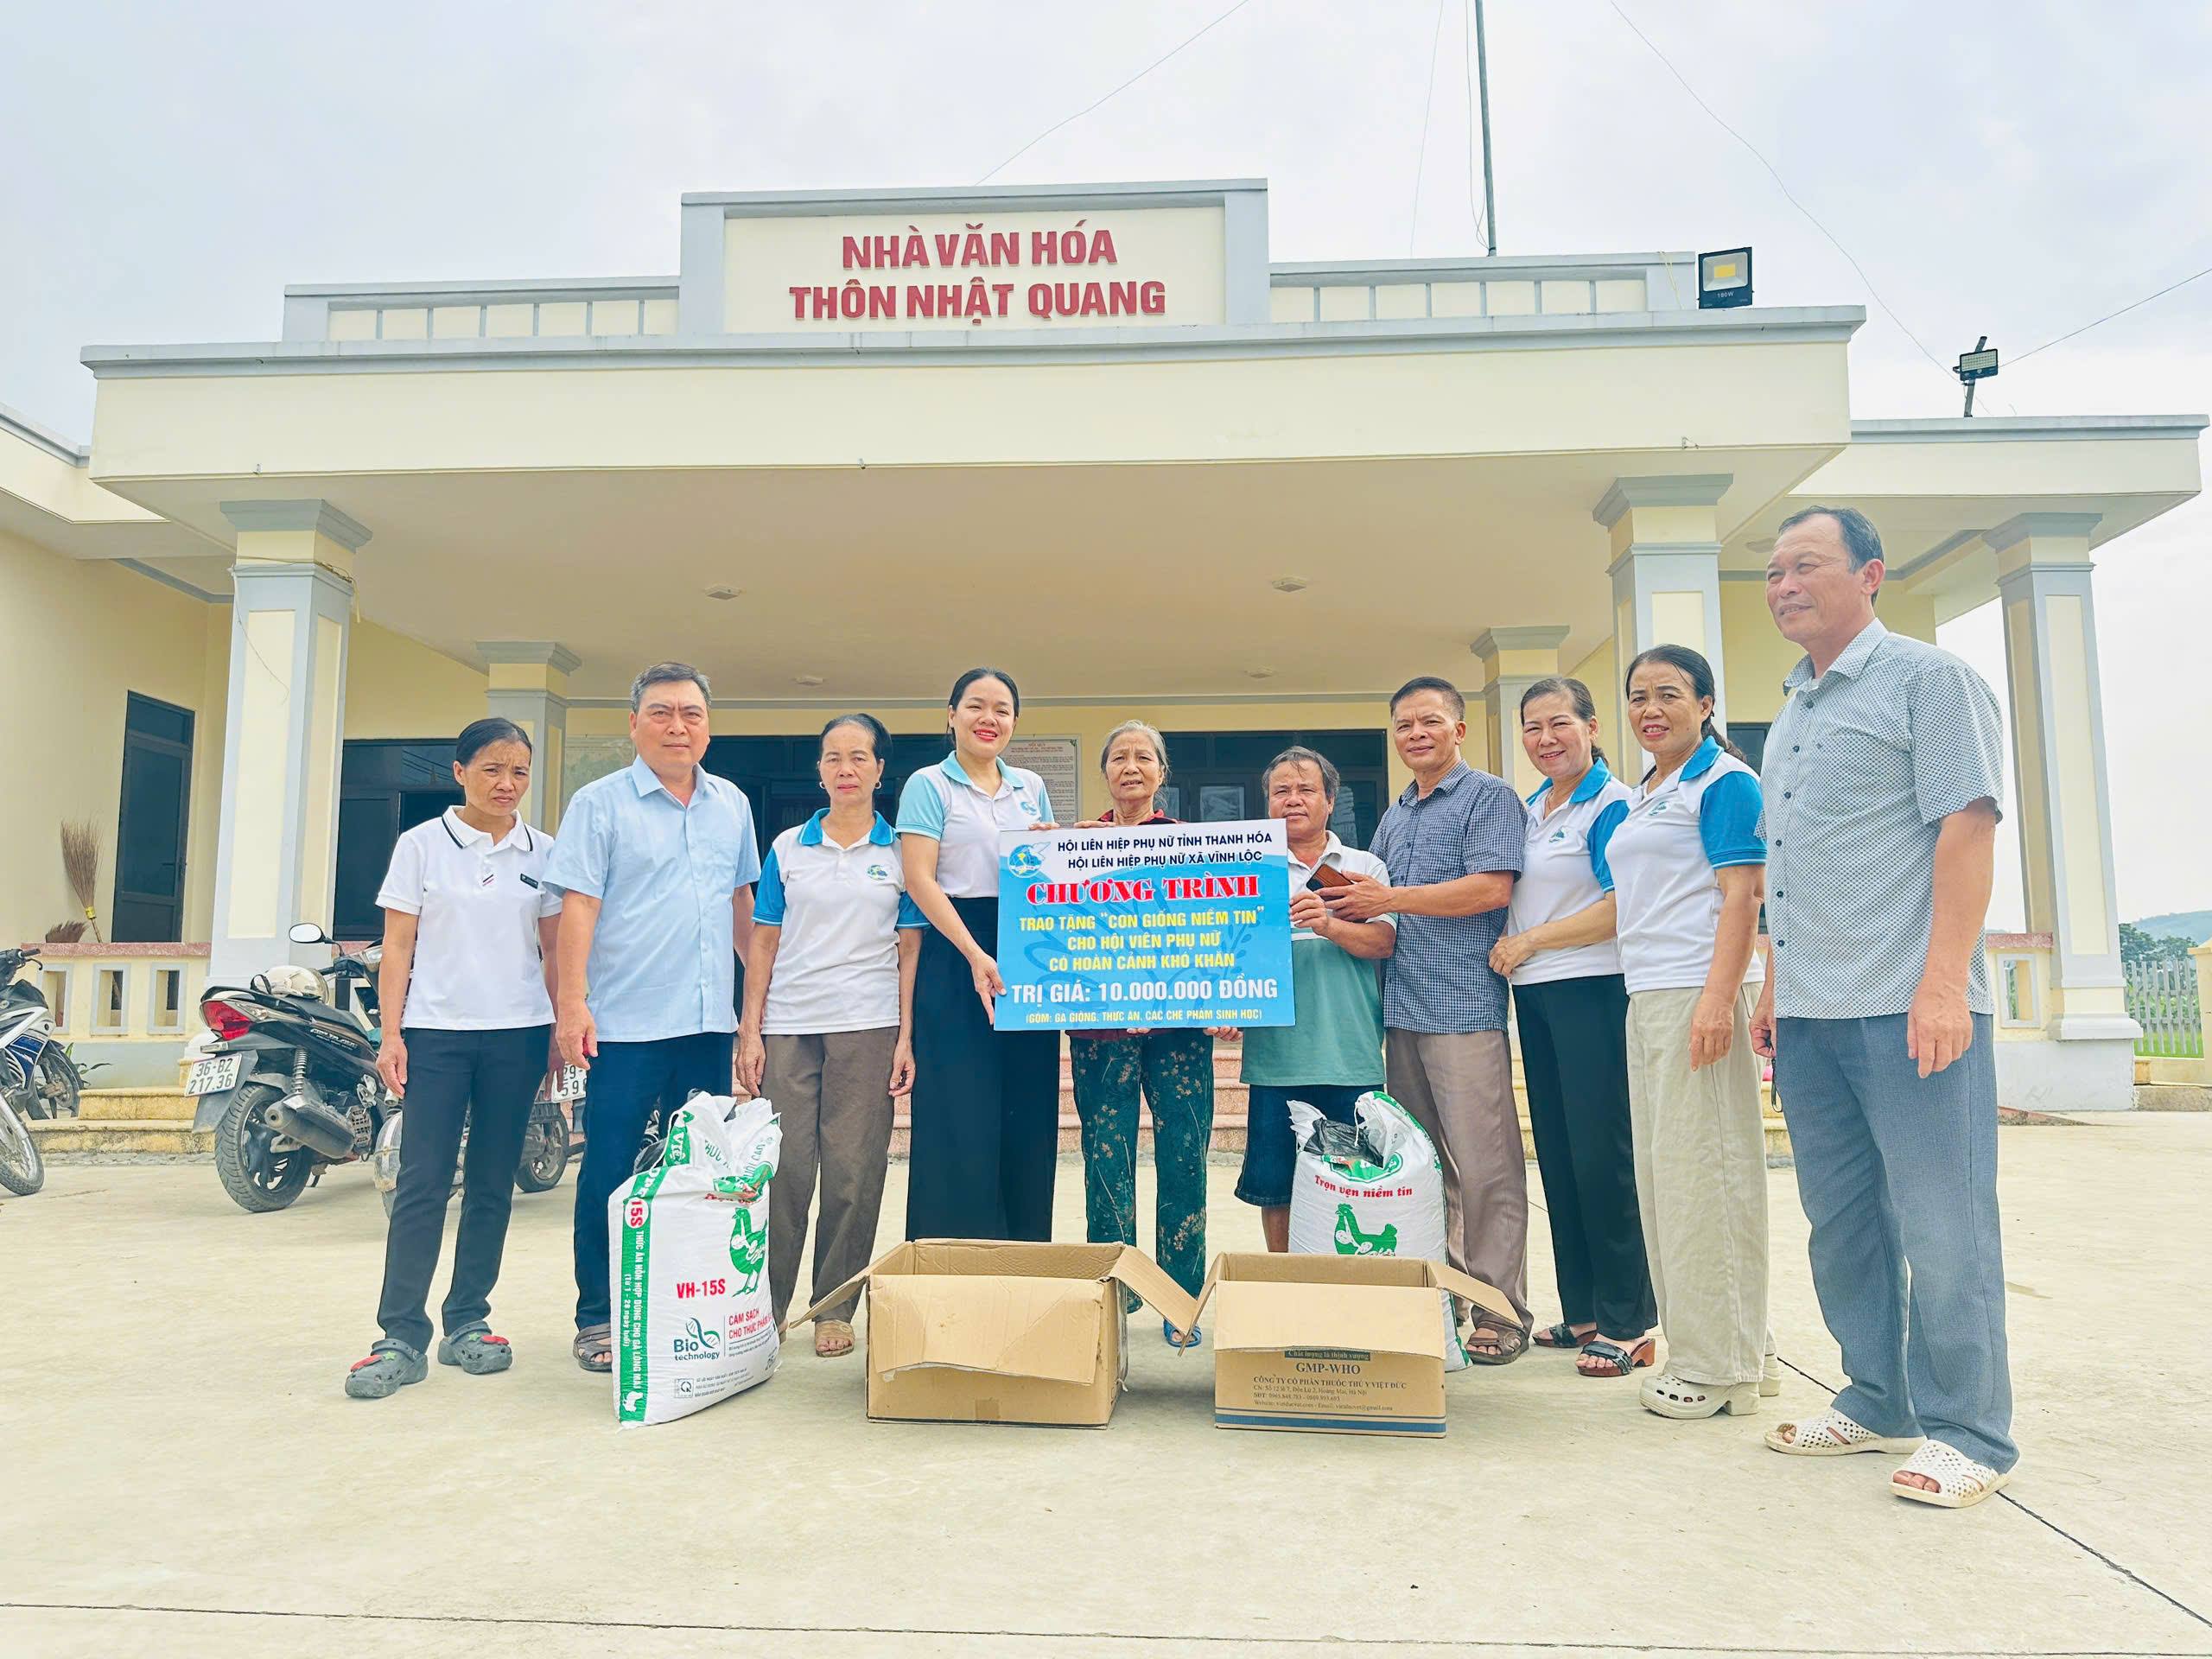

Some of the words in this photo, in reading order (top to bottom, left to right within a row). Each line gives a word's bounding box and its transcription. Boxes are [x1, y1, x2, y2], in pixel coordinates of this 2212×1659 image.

[842, 225, 931, 270] NHÀ
[935, 222, 1020, 268] VĂN
[1032, 219, 1118, 266] HÓA
[790, 278, 896, 321] THÔN
[906, 276, 1014, 326] NHẬT
[1028, 281, 1166, 321] QUANG
[1058, 839, 1077, 854] HỘI
[1081, 838, 1103, 851] LIÊN
[1107, 837, 1129, 852] HIỆP
[1134, 837, 1155, 851] PHỤ
[1159, 835, 1174, 848] NỮ
[1177, 834, 1202, 847] TỈNH
[1205, 834, 1243, 845] THANH
[1247, 830, 1272, 843] HÓA
[1068, 856, 1088, 871] HỘI
[1091, 855, 1113, 868] LIÊN
[1117, 855, 1141, 870] HIỆP
[1144, 855, 1166, 868] PHỤ
[1169, 853, 1185, 865] NỮ
[1189, 852, 1205, 864] XÃ
[1208, 851, 1235, 863] VĨNH
[1238, 849, 1262, 863] LỘC
[1027, 878, 1154, 905] CHƯƠNG
[1162, 871, 1261, 900] TRÌNH
[1019, 917, 1055, 931] TRAO
[1058, 914, 1096, 933] TẶNG
[1142, 908, 1186, 928] GIỐNG
[1191, 907, 1229, 926] NIỀM
[1067, 936, 1096, 950] CHO
[1100, 932, 1124, 952] HỘI
[1128, 932, 1161, 949] VIÊN
[1166, 933, 1195, 950] PHỤ
[1200, 930, 1221, 946] NỮ
[1049, 955, 1068, 971] CÓ
[1072, 954, 1112, 970] HOÀN
[1116, 951, 1156, 969] CẢNH
[1160, 951, 1190, 969] KHÓ
[1195, 950, 1235, 968] KHĂN
[1011, 984, 1043, 1007] TRỊ
[1050, 979, 1090, 1003] GIÁ:
[1098, 981, 1211, 1001] 10.000.000
[1218, 973, 1278, 999] ĐỒNG
[1216, 1009, 1237, 1020] SINH
[196, 1058, 233, 1077] 36-B2
[188, 1073, 233, 1095] 217.36
[1314, 1174, 1336, 1192] Trọn
[1339, 1185, 1359, 1198] vẹn
[1363, 1185, 1394, 1198] niềm
[631, 1201, 643, 1227] 15S
[677, 1278, 726, 1299] VH-15S
[674, 1338, 699, 1352] Bio
[675, 1351, 720, 1361] technology
[1253, 1375, 1274, 1383] CÔNG
[1296, 1362, 1361, 1375] GMP-WHO
